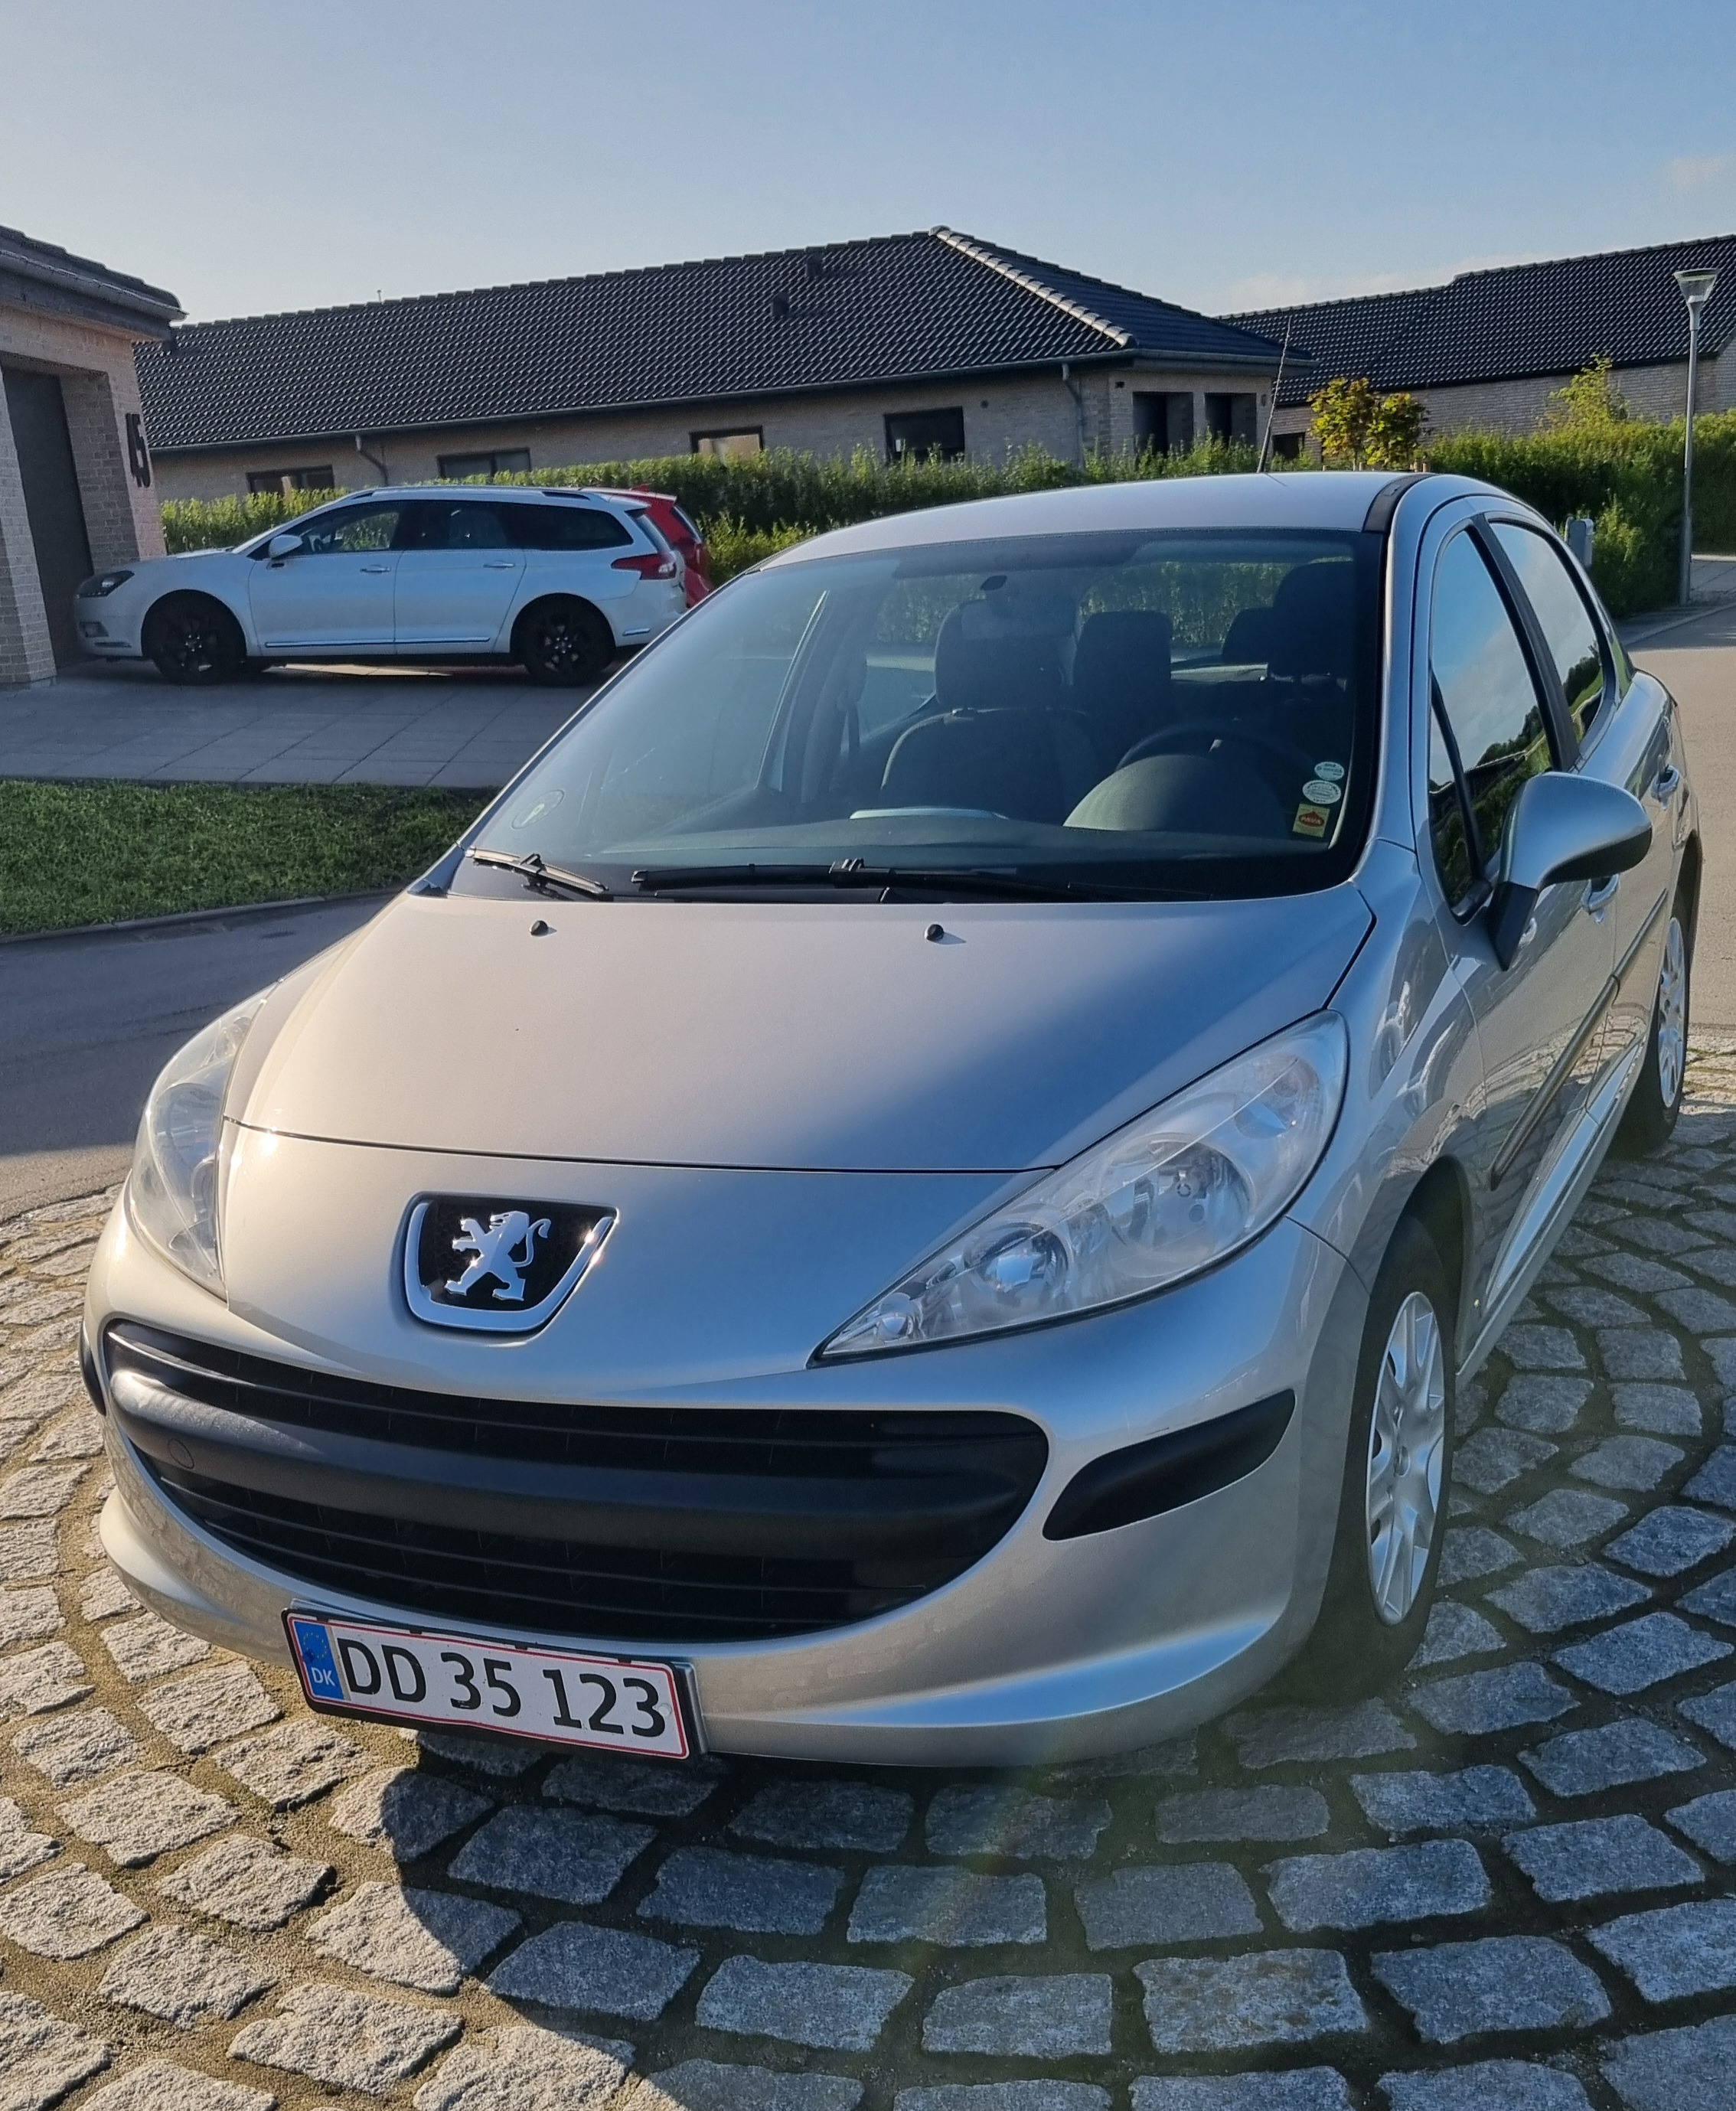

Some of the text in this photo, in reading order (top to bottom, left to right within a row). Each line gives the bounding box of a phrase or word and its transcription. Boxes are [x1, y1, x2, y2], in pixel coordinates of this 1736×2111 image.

[311, 1667, 336, 1687] DK
[337, 1637, 666, 1738] DD 35 123
